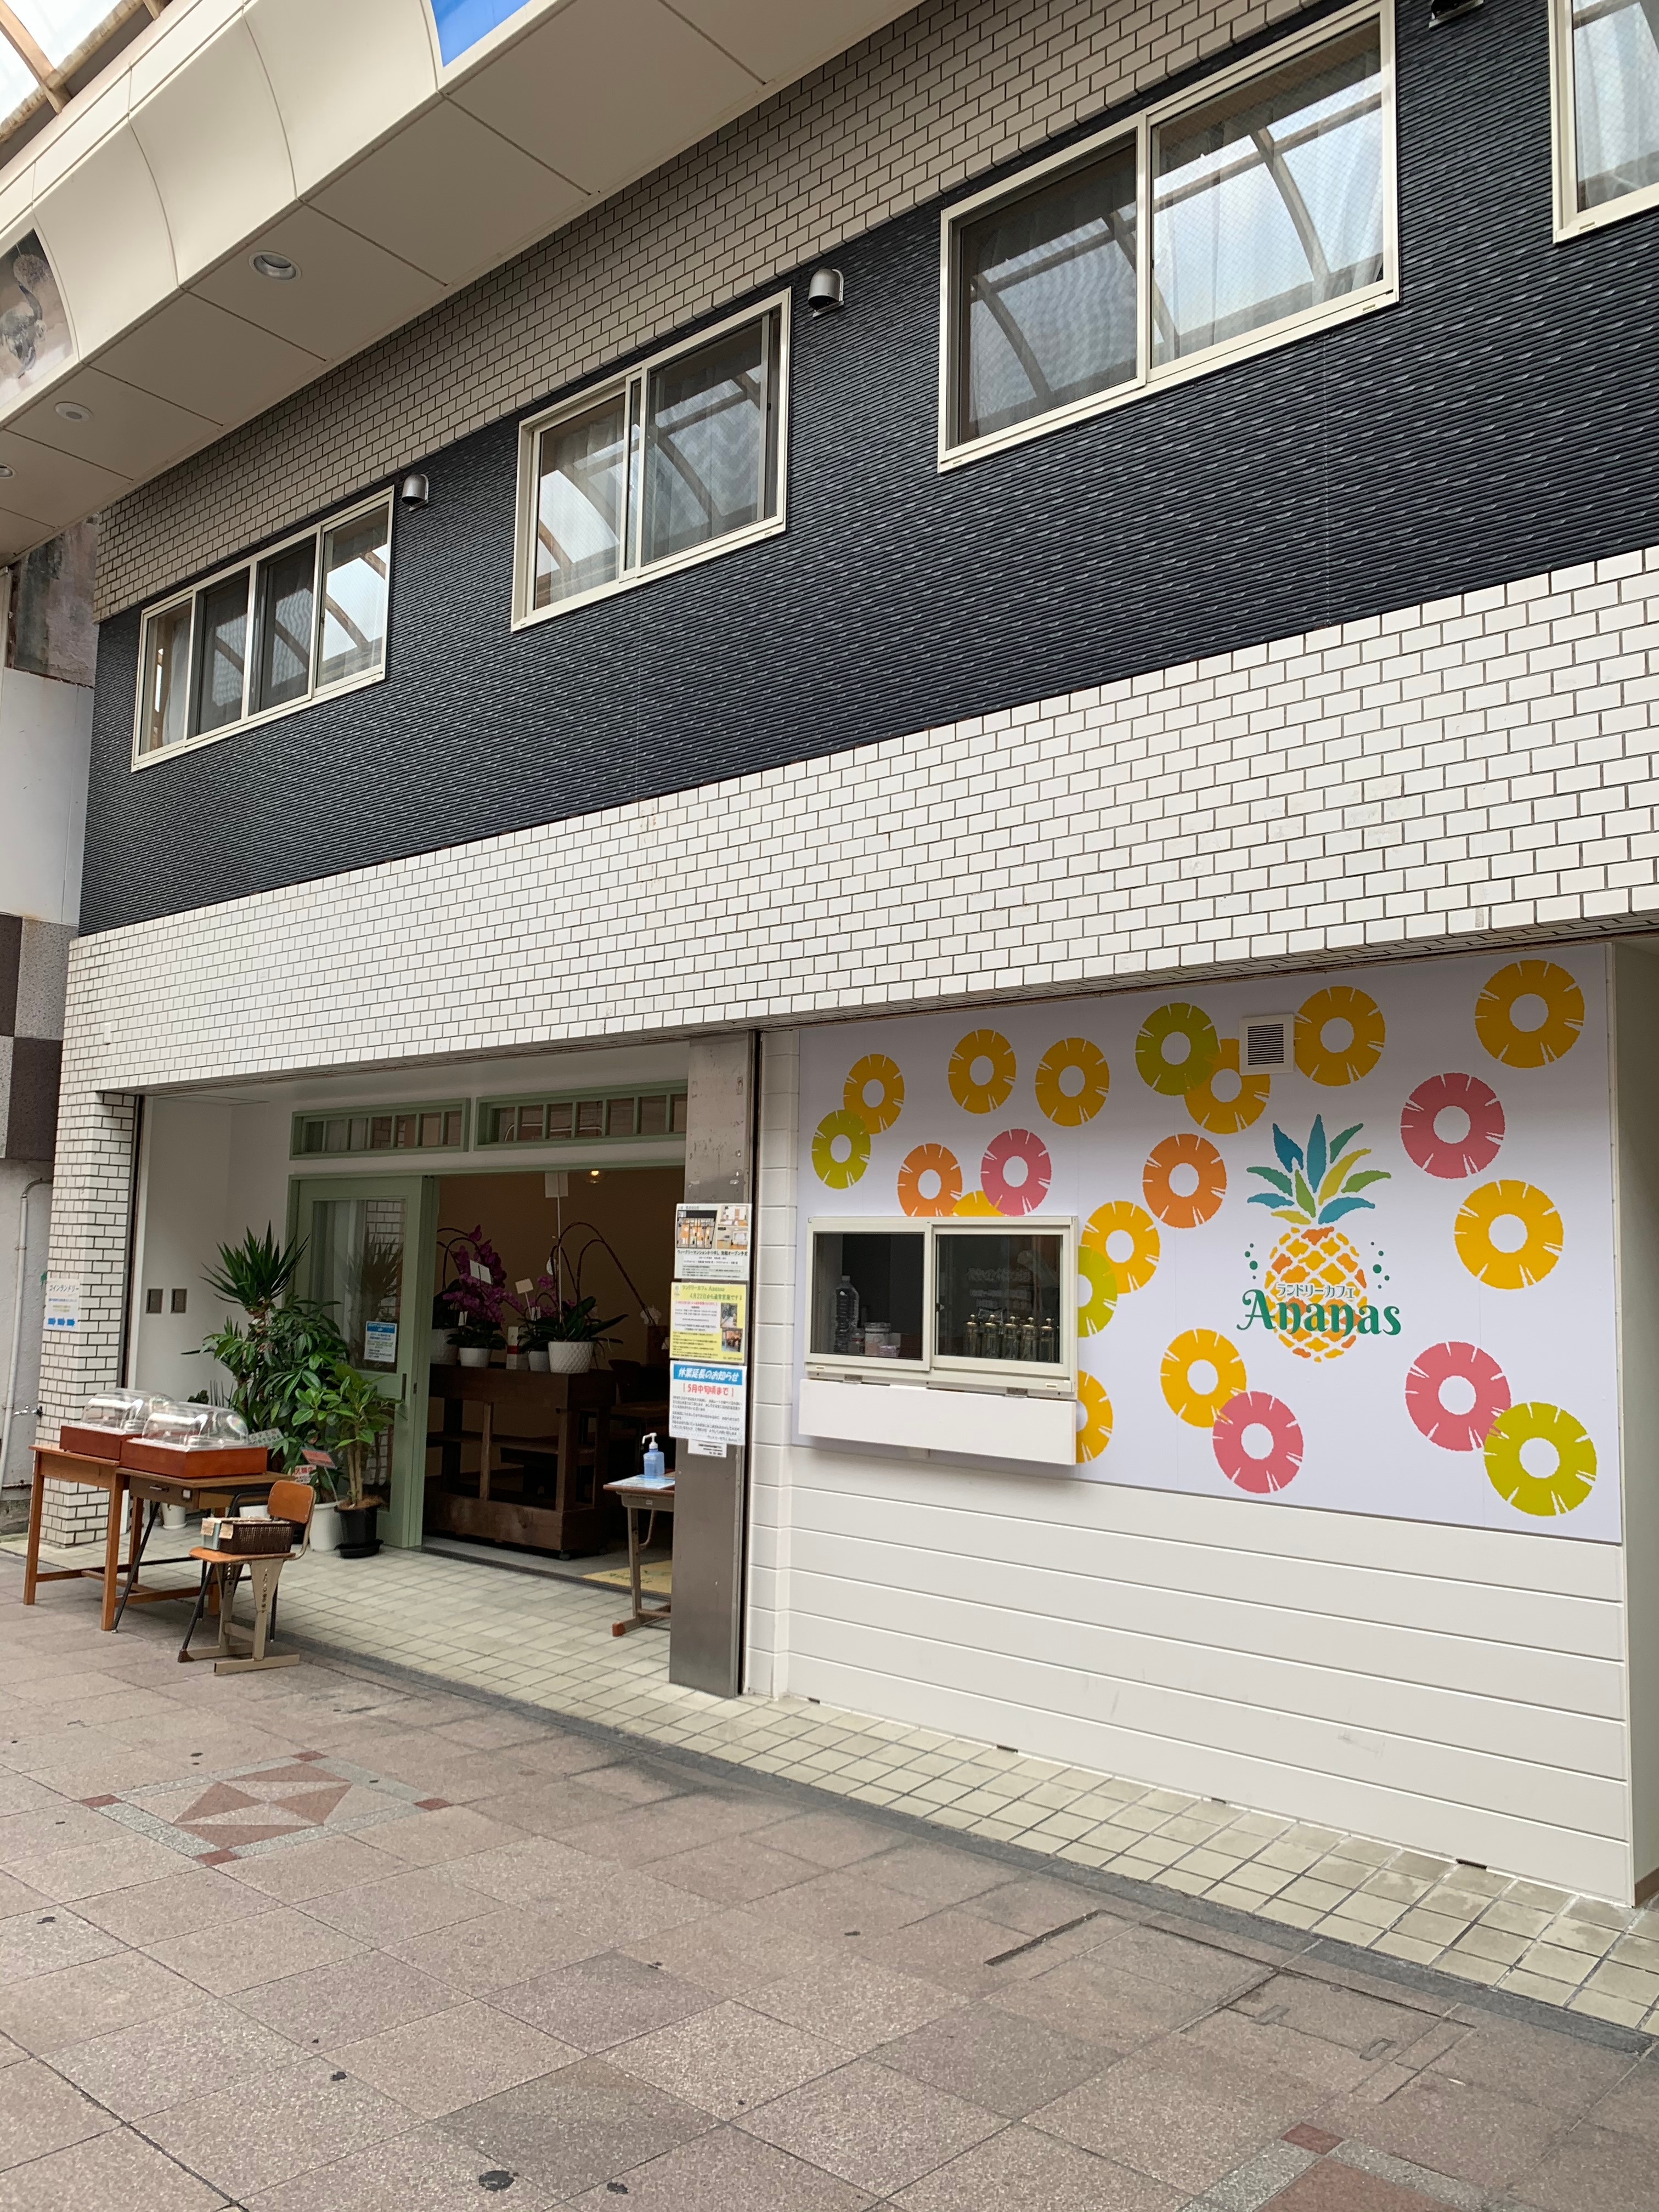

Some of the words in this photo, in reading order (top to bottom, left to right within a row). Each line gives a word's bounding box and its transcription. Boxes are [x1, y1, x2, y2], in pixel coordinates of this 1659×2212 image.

[1277, 1284, 1355, 1298] ランドリーカフェ
[1236, 1289, 1402, 1336] Ananas
[679, 1367, 739, 1381] 休業延長のお知らせ
